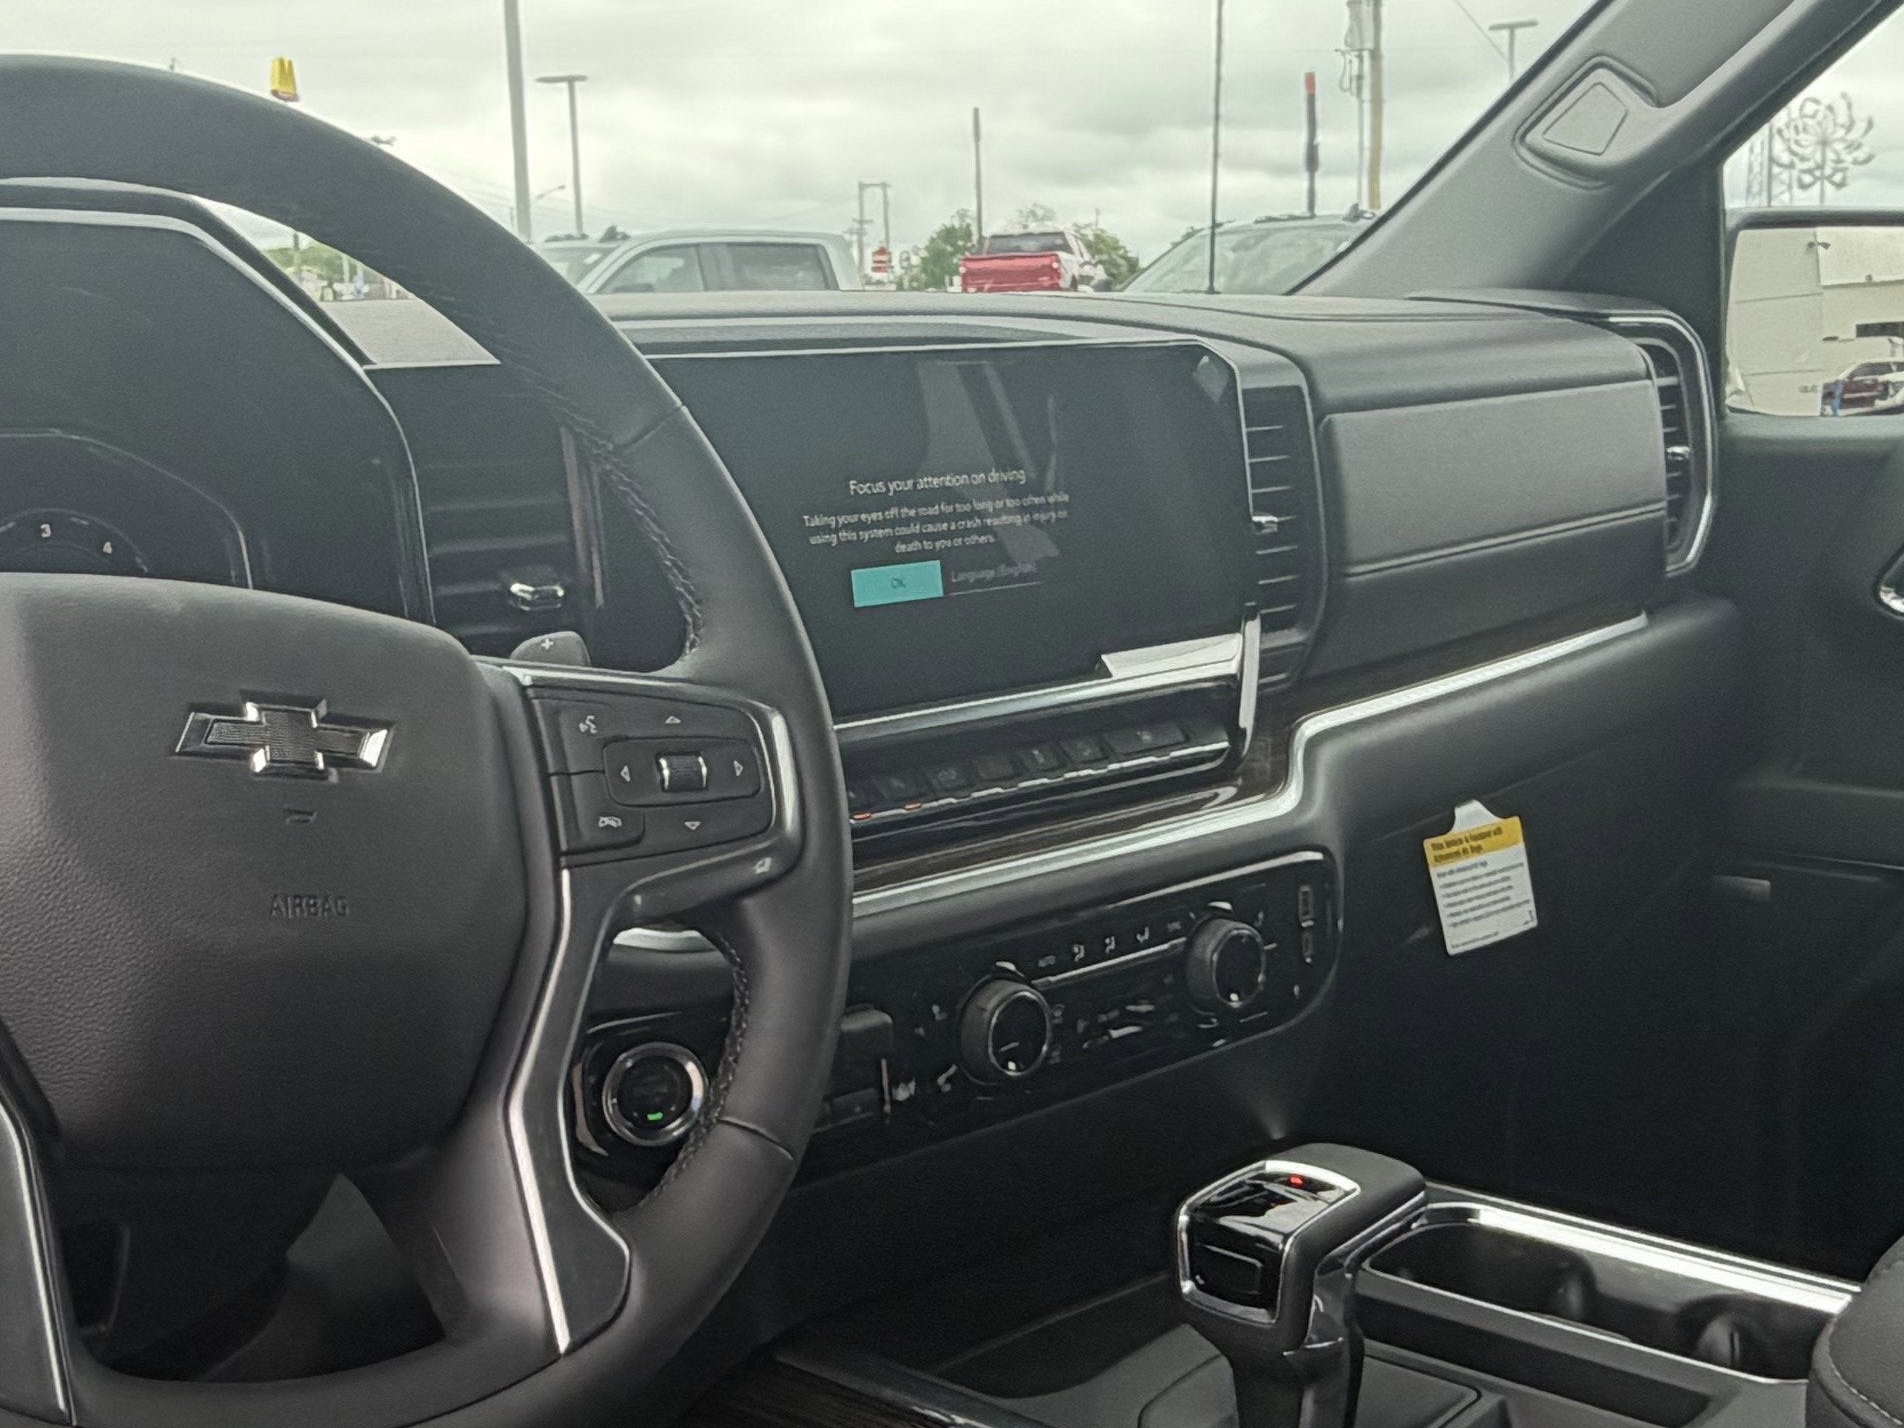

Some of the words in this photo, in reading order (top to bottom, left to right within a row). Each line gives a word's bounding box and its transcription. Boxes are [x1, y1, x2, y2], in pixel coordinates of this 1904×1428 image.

[849, 479, 887, 495] Focus
[887, 478, 914, 496] your
[916, 472, 969, 490] attention
[970, 473, 986, 485] on
[987, 467, 1026, 485] driving
[803, 514, 836, 529] Taking
[837, 514, 859, 528] your
[860, 511, 883, 524] eyes
[40, 523, 52, 538] 3
[102, 541, 113, 554] 4
[270, 894, 349, 919] AIRBAG
